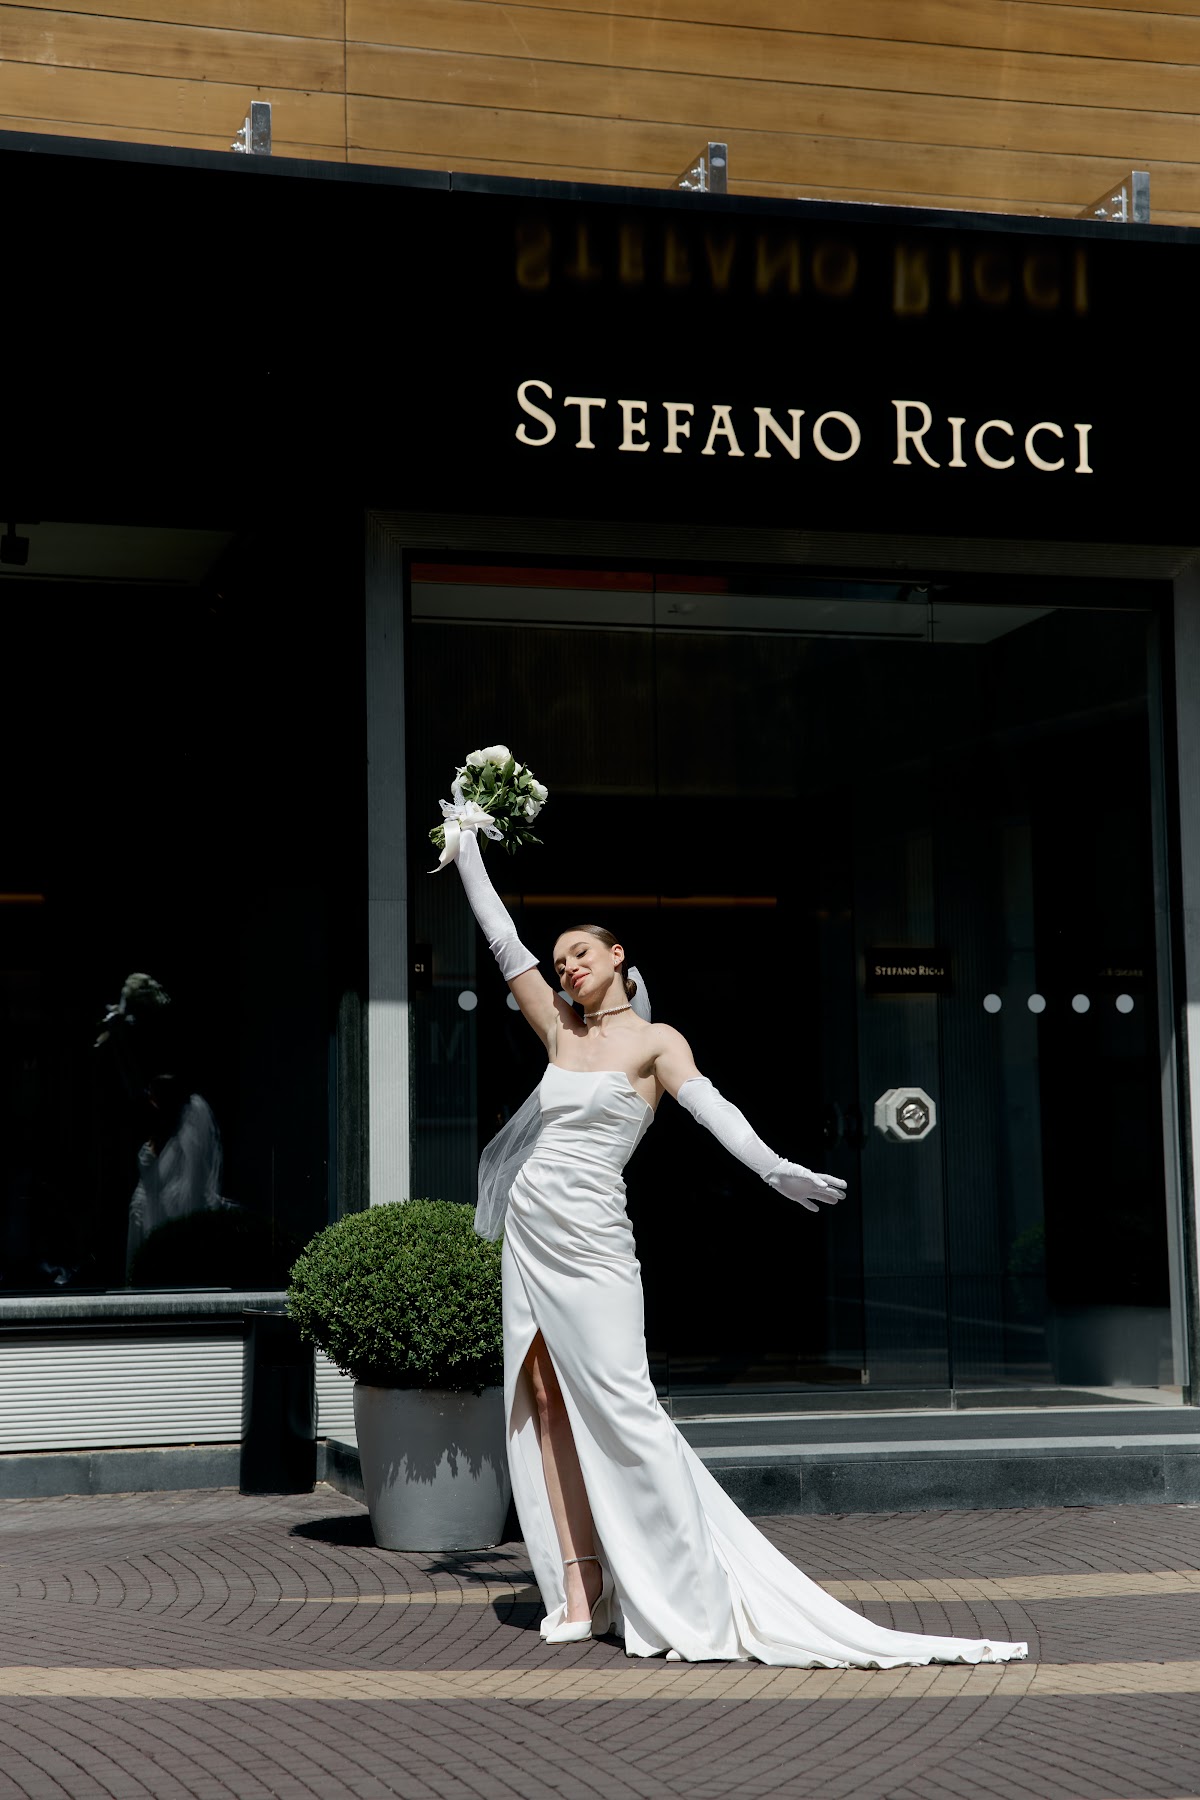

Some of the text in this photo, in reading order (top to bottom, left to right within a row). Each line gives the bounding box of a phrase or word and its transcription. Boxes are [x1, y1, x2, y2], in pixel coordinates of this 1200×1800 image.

[515, 379, 1094, 474] STEFANO RICCI
[874, 965, 917, 976] STEFANO
